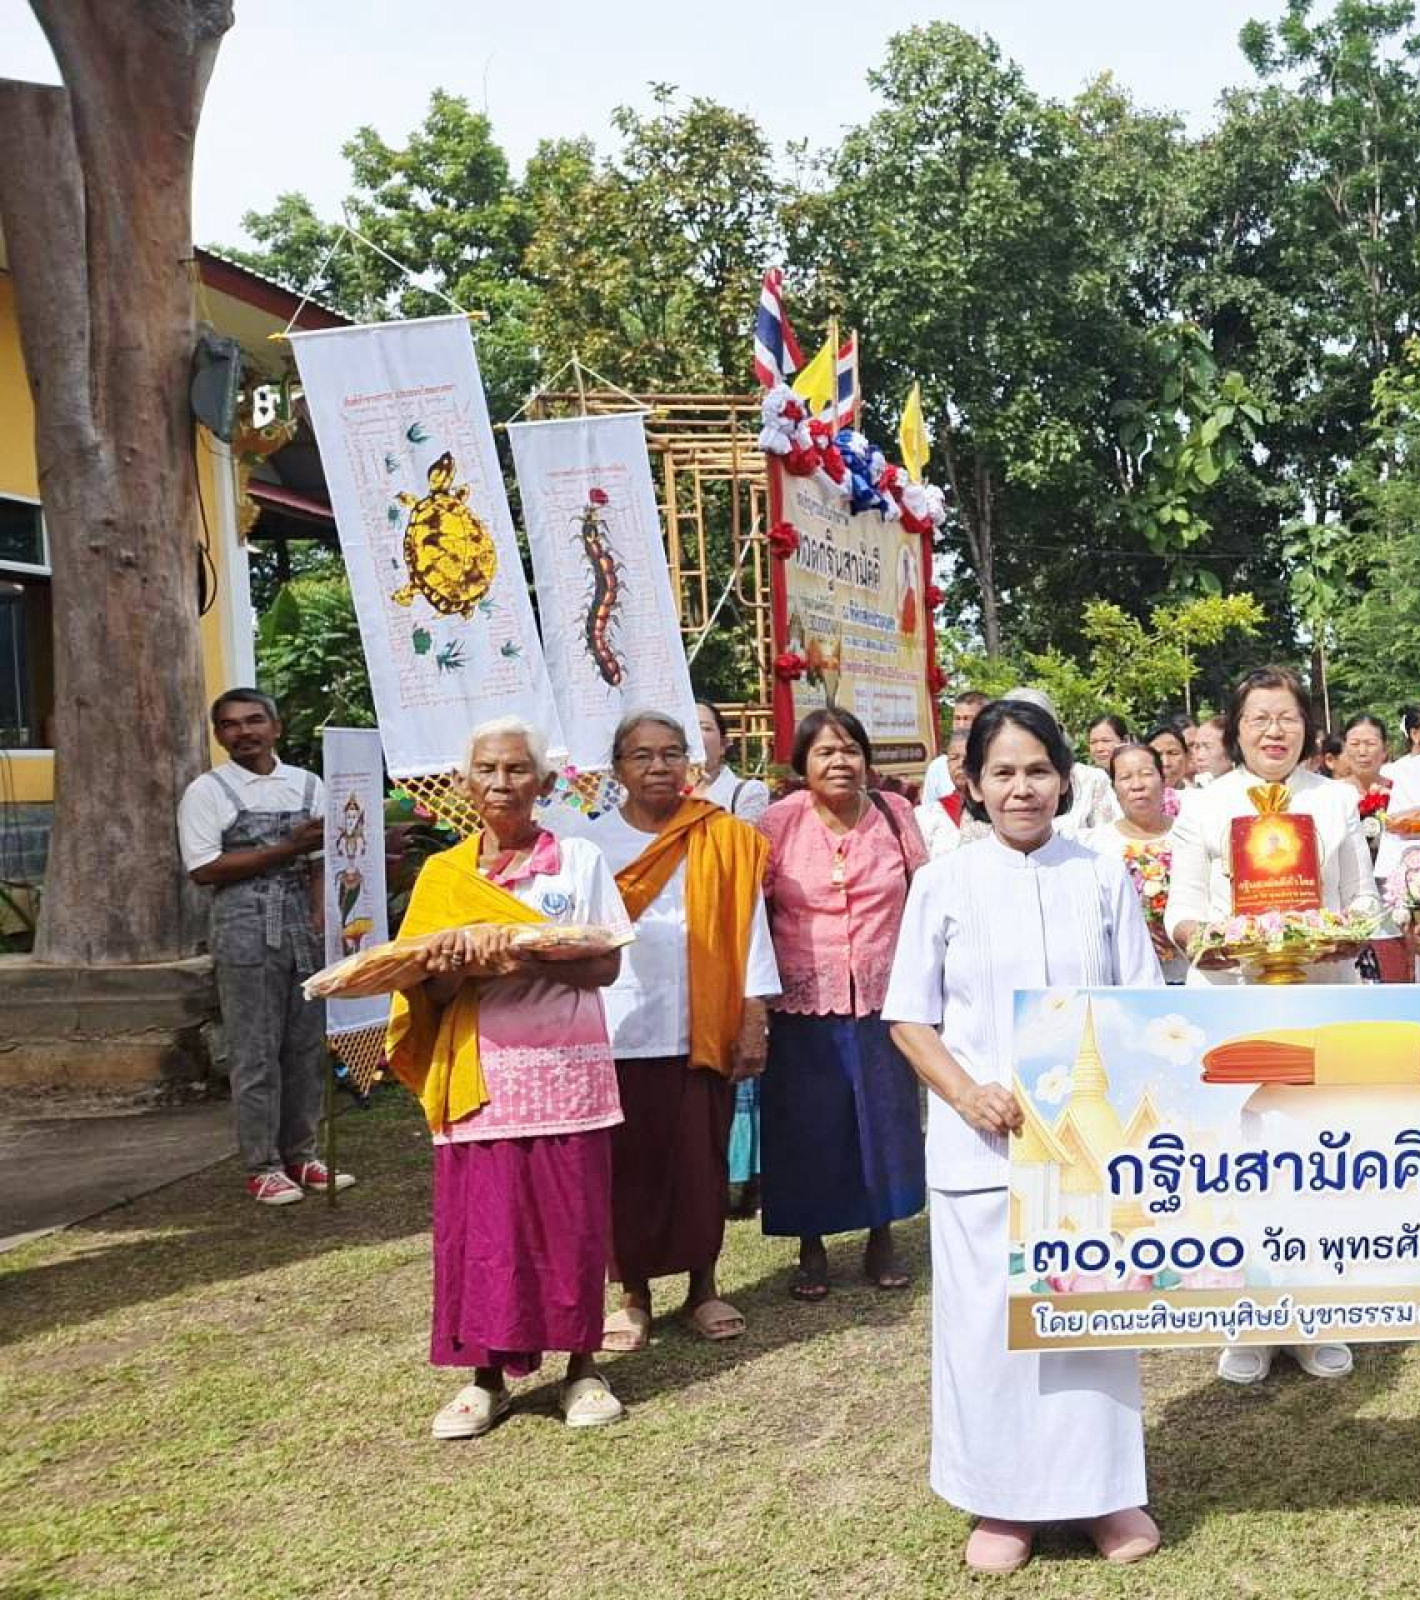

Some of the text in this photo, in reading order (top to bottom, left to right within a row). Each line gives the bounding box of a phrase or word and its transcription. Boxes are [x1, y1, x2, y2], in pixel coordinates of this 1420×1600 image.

[1033, 1236, 1245, 1278] ๓๐,๐๐๐
[1262, 1226, 1306, 1261] วัด
[1036, 1306, 1083, 1333] โดย
[1092, 1298, 1289, 1335] คณะศิษยานุศิษย์
